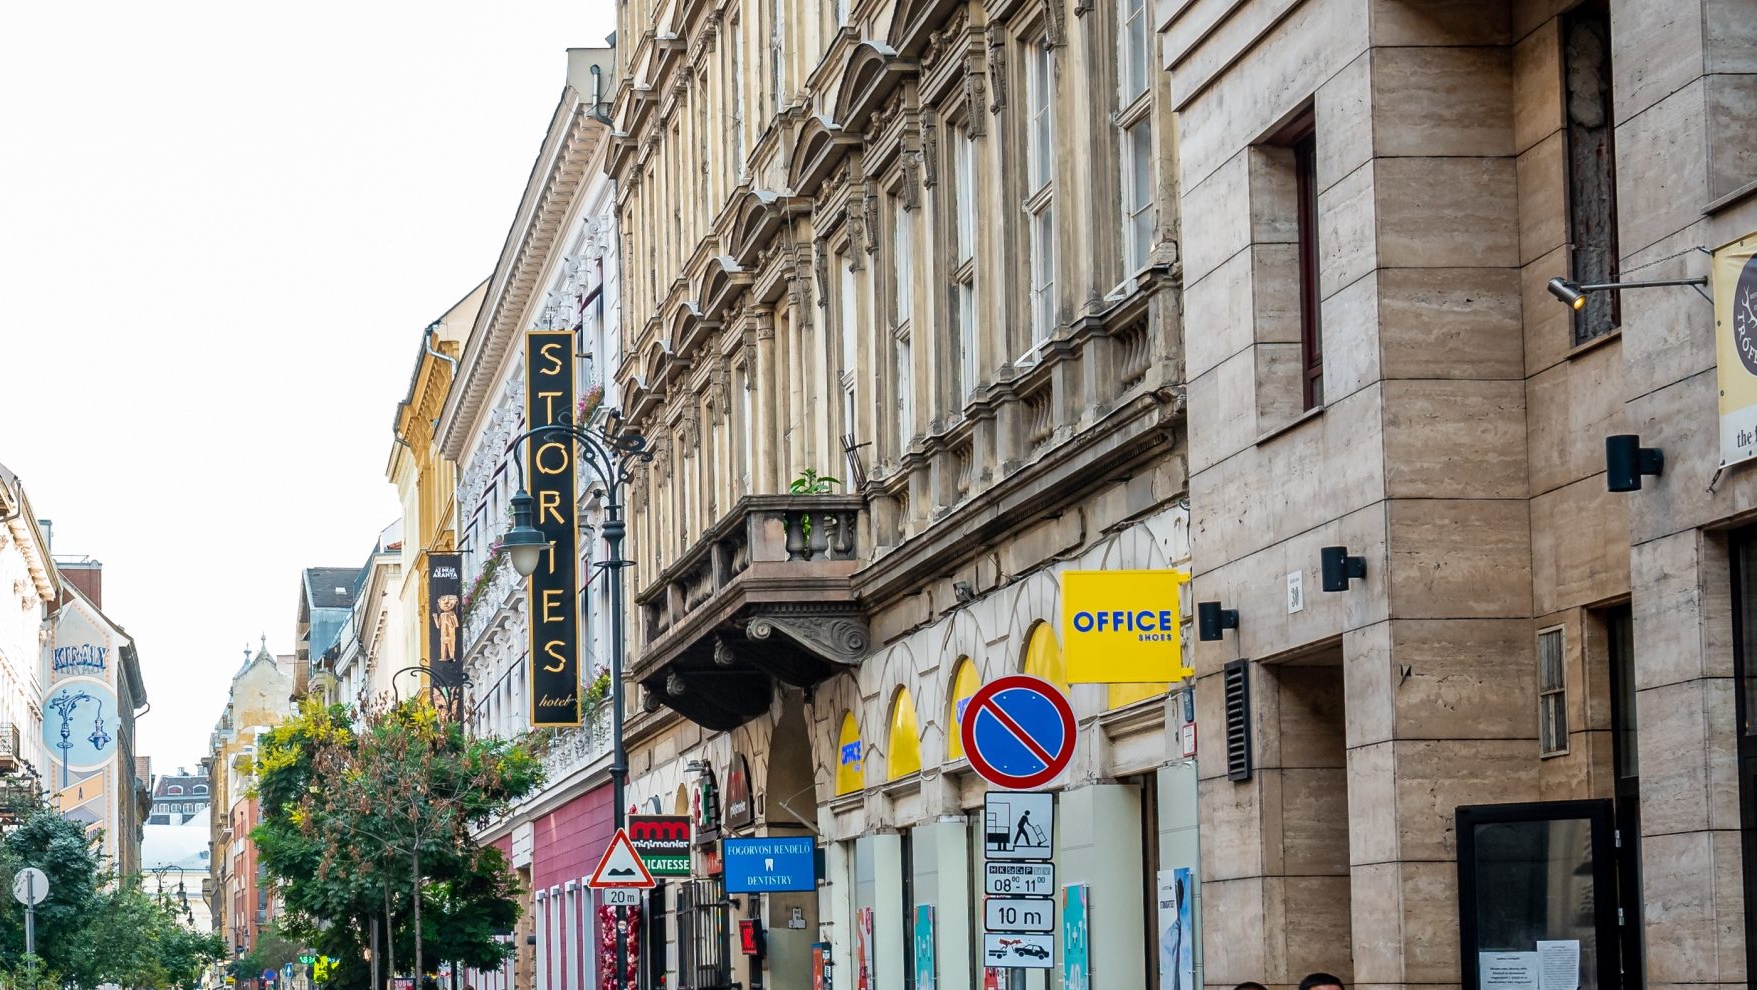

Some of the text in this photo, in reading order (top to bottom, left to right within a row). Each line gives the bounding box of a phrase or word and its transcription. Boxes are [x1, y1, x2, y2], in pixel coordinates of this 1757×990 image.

[1737, 430, 1752, 449] the
[536, 342, 569, 674] STORIES
[1073, 610, 1172, 632] OFFICE
[1138, 633, 1172, 642] SHOES
[52, 643, 108, 671] KIRÁLY
[539, 692, 576, 708] hotel
[728, 845, 772, 856] FOGORVOSI
[643, 859, 690, 870] LICATESSE
[747, 875, 792, 886] DENTISTRY
[610, 891, 635, 902] 20 m
[998, 907, 1041, 924] 10 m
